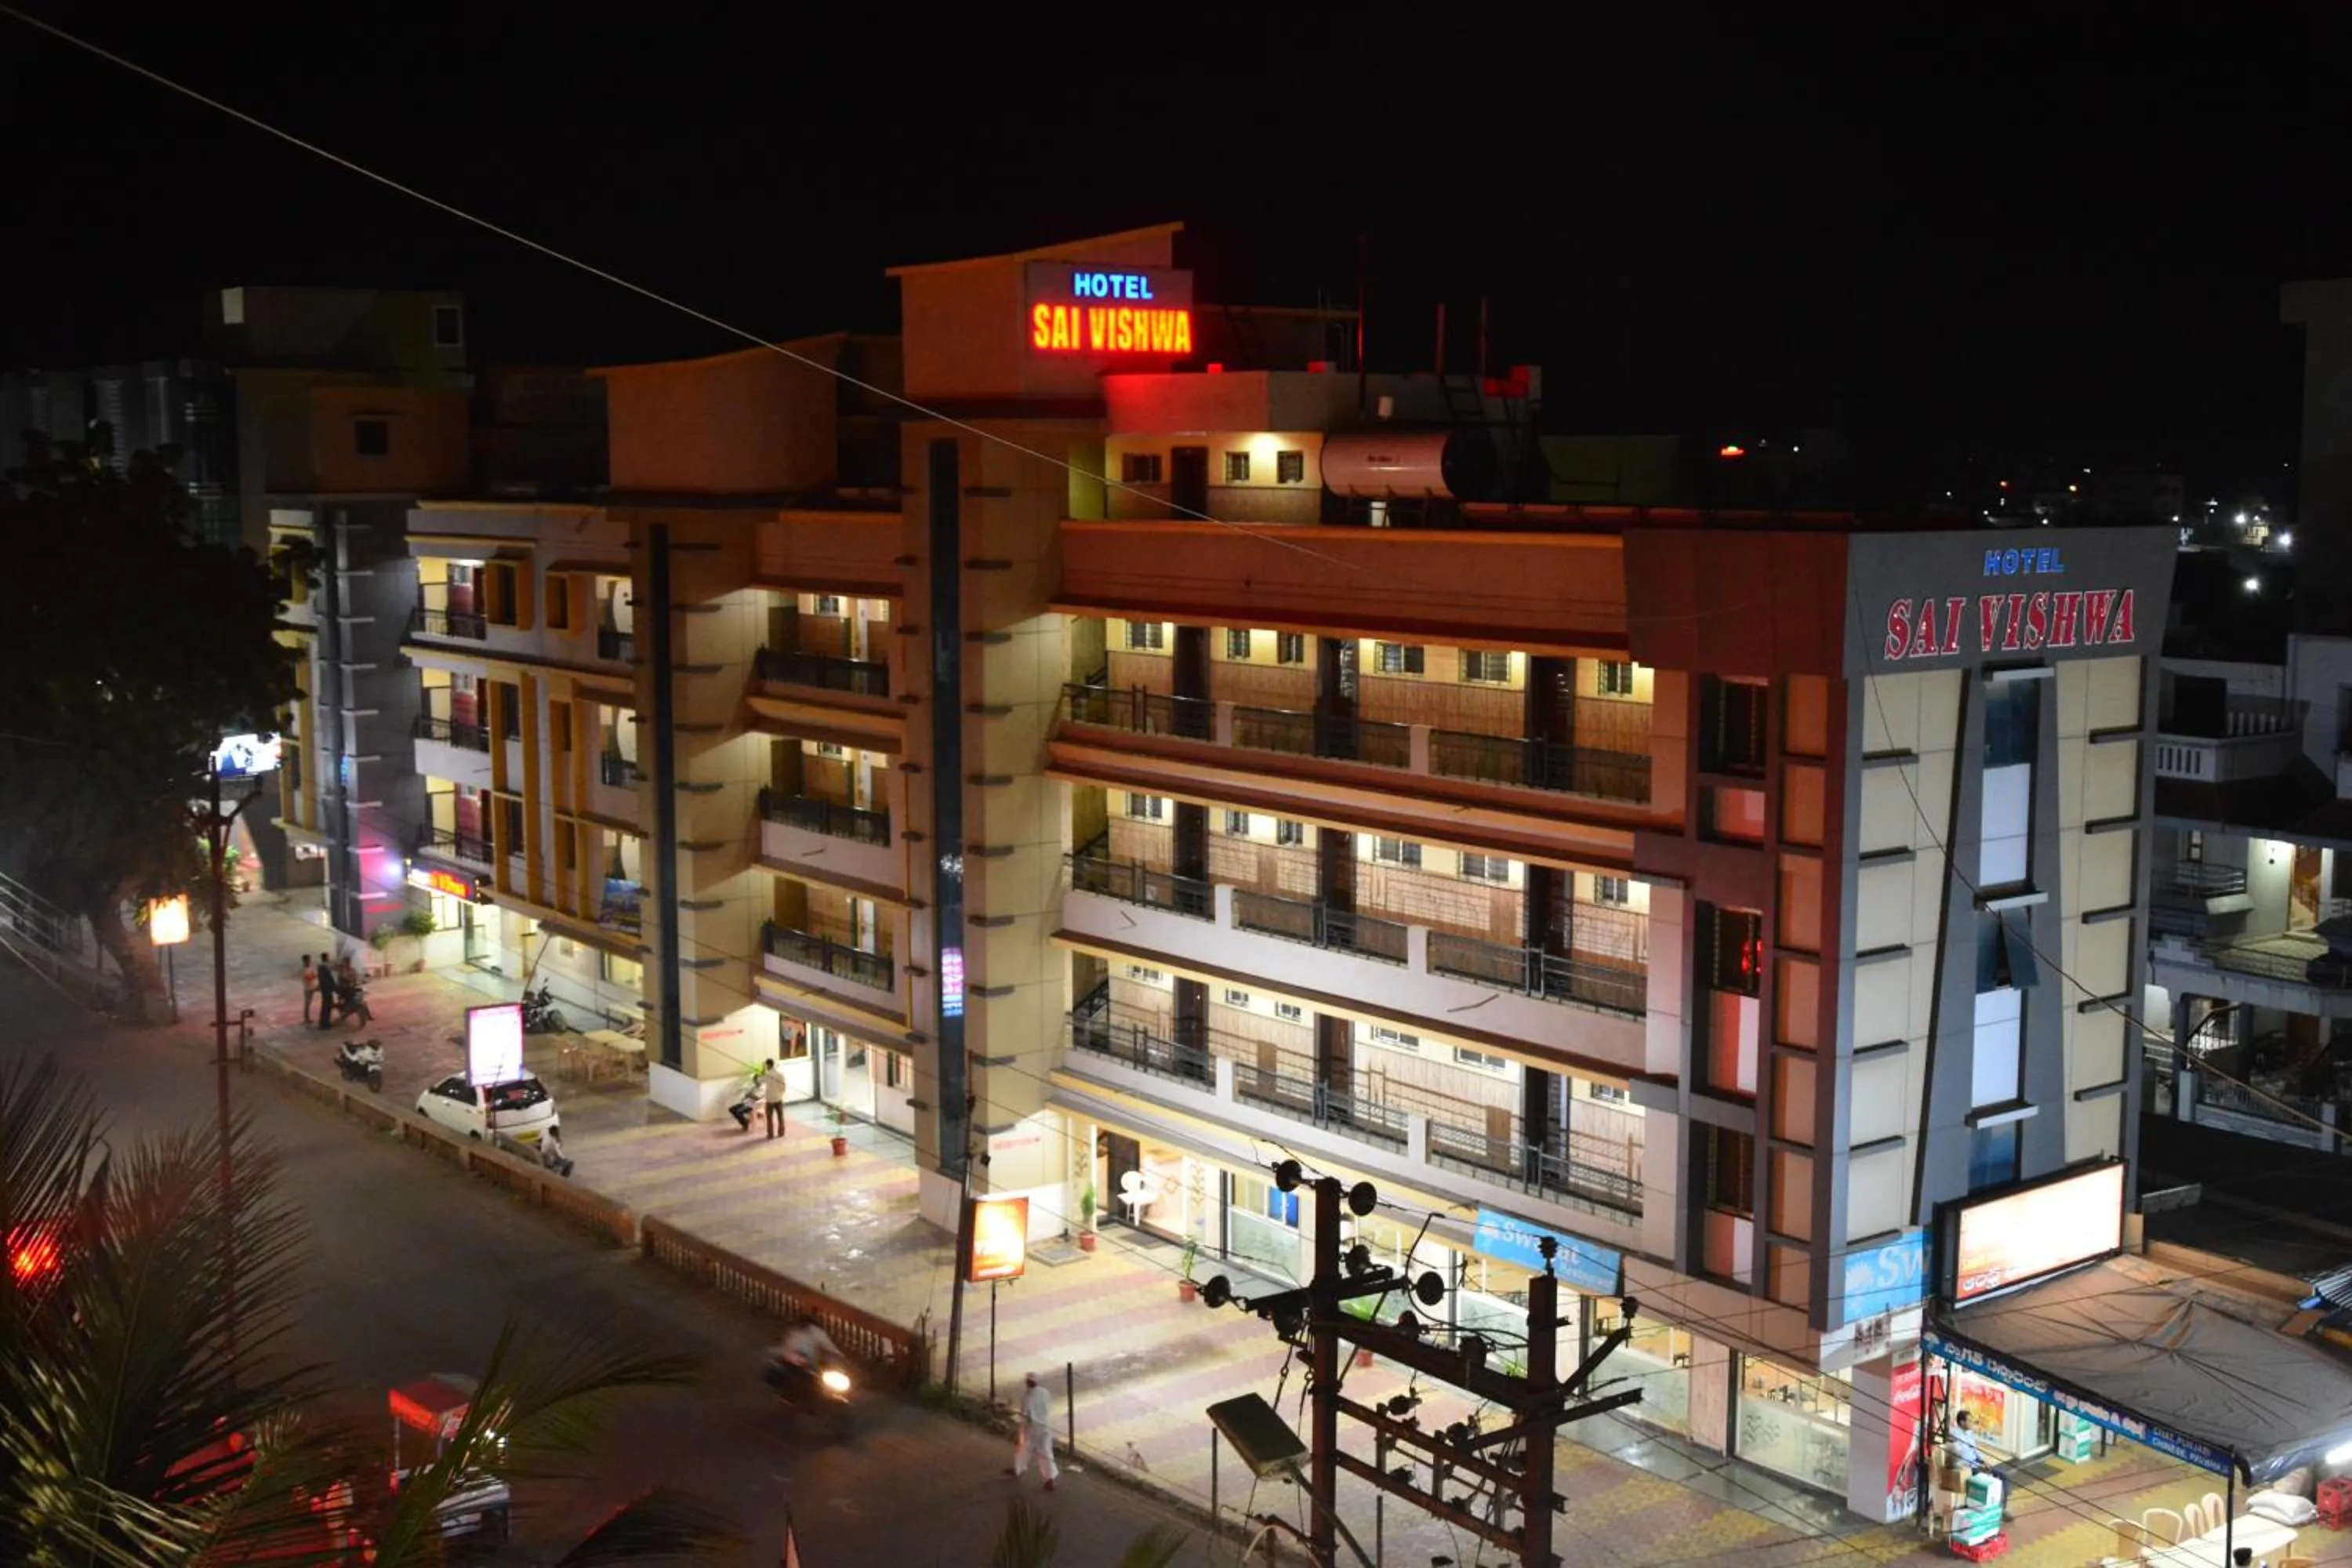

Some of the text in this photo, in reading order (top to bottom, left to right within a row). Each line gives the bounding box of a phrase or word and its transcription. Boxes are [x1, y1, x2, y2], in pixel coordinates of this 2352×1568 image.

[1073, 272, 1153, 299] HOTEL
[1032, 303, 1192, 354] SAI VISHWA
[1983, 548, 2064, 577] HOTEL
[1883, 589, 2134, 661] SAI VISHWA
